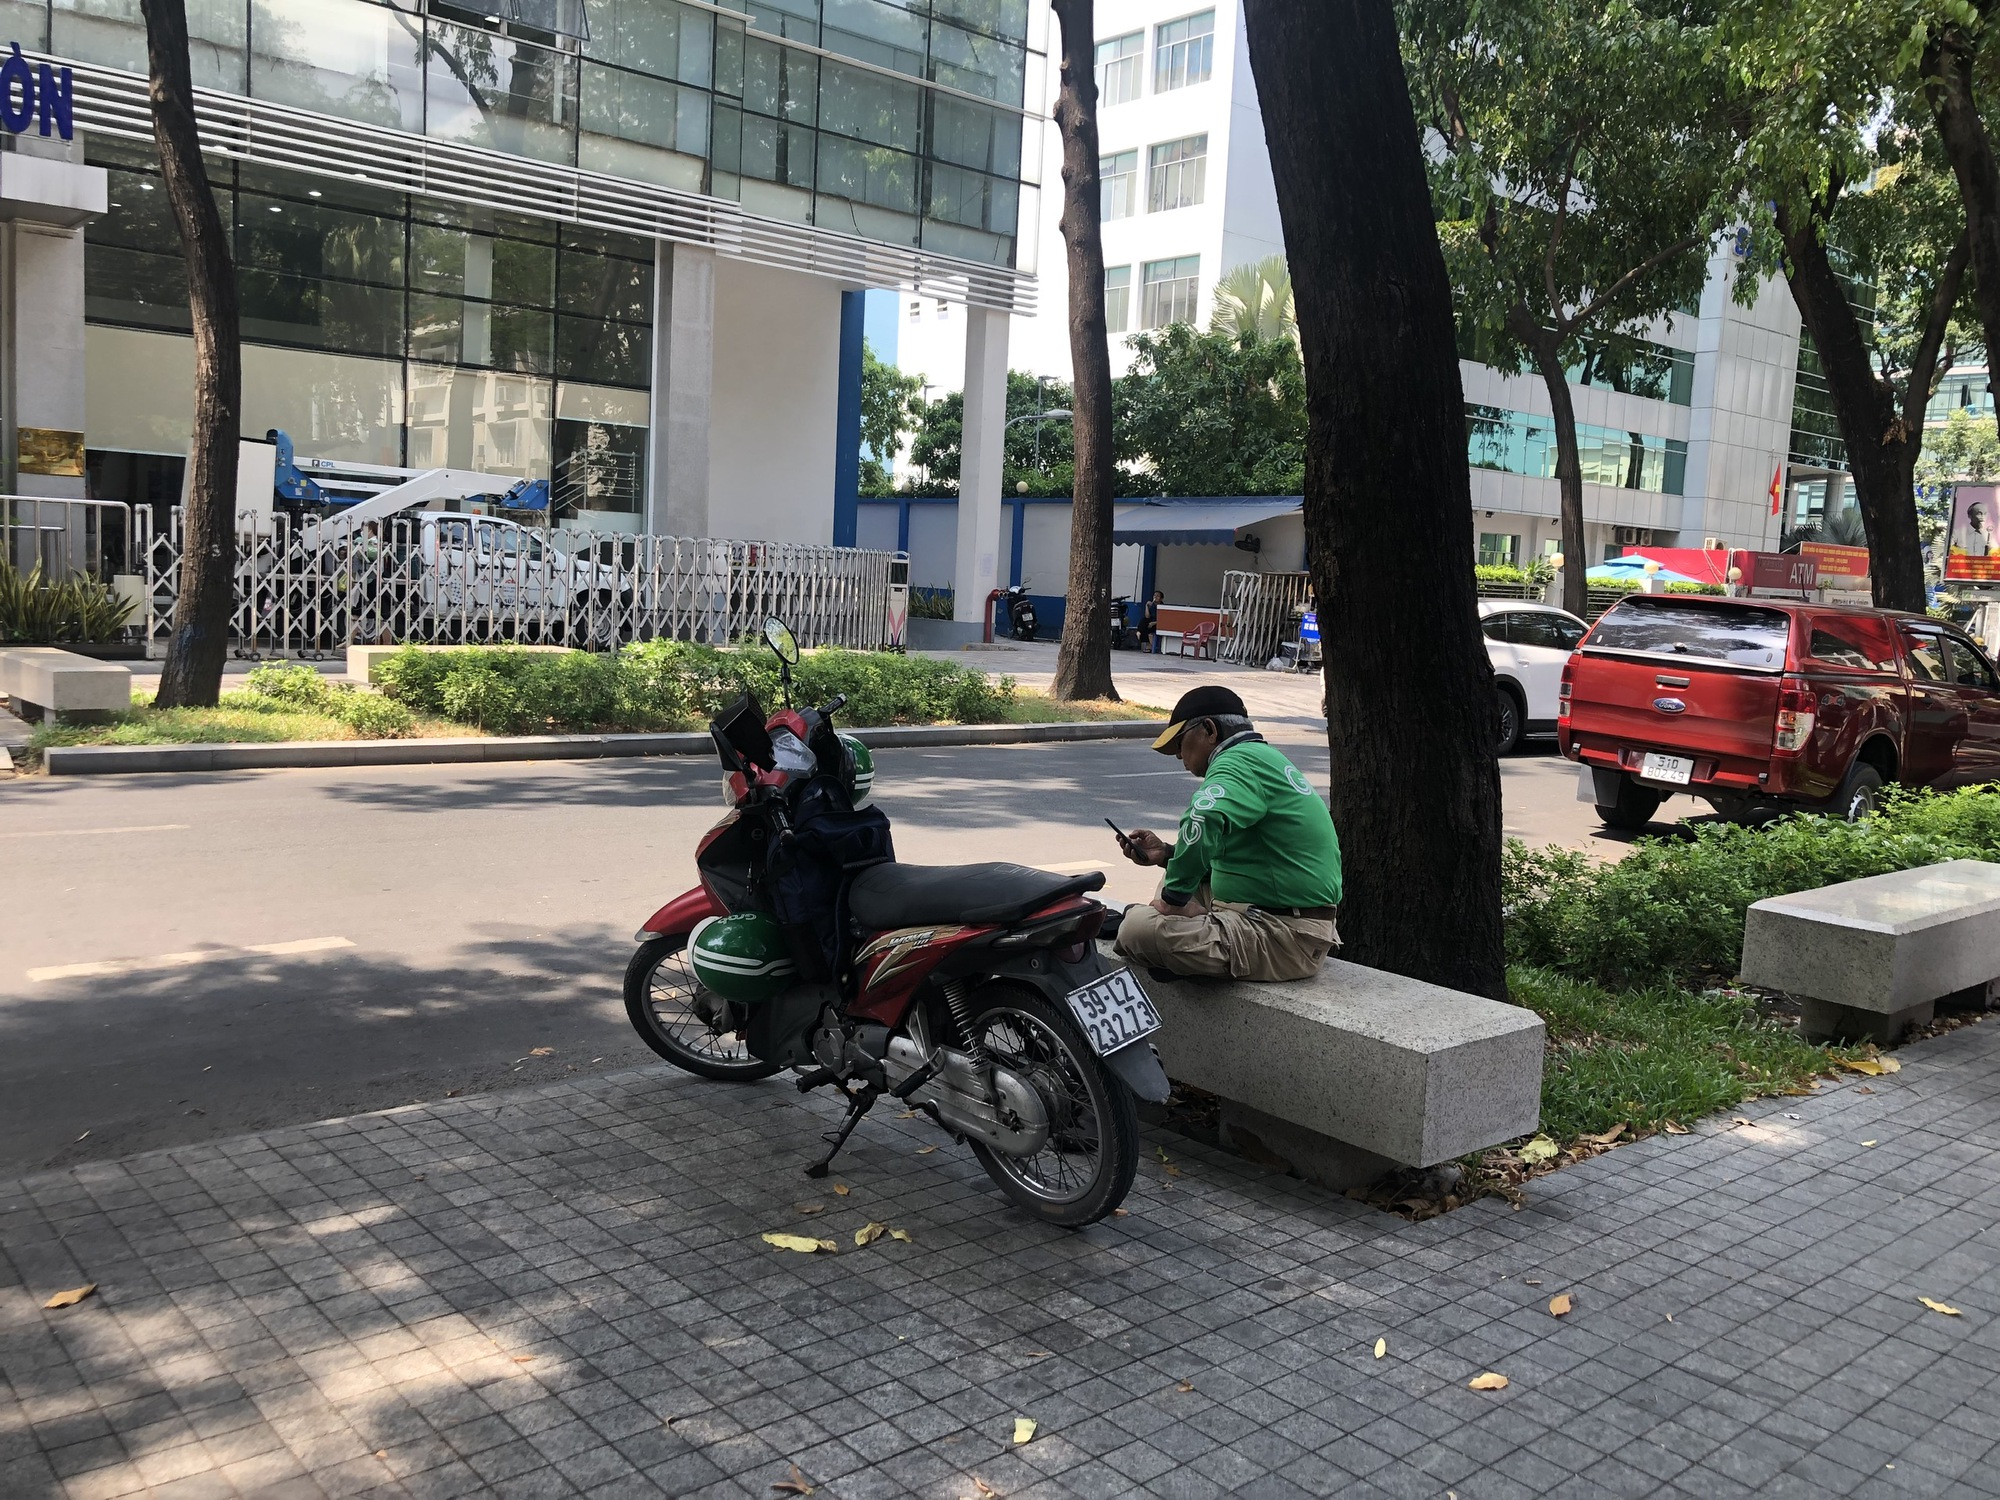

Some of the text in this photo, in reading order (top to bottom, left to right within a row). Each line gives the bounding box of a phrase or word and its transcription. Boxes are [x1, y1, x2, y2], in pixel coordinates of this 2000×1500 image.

[1790, 563, 1814, 585] ATM
[1656, 699, 1681, 710] Ford
[1657, 756, 1679, 769] 51D
[1647, 766, 1685, 781] 802.49
[1182, 783, 1226, 846] Grab
[1089, 1000, 1155, 1051] 232.73
